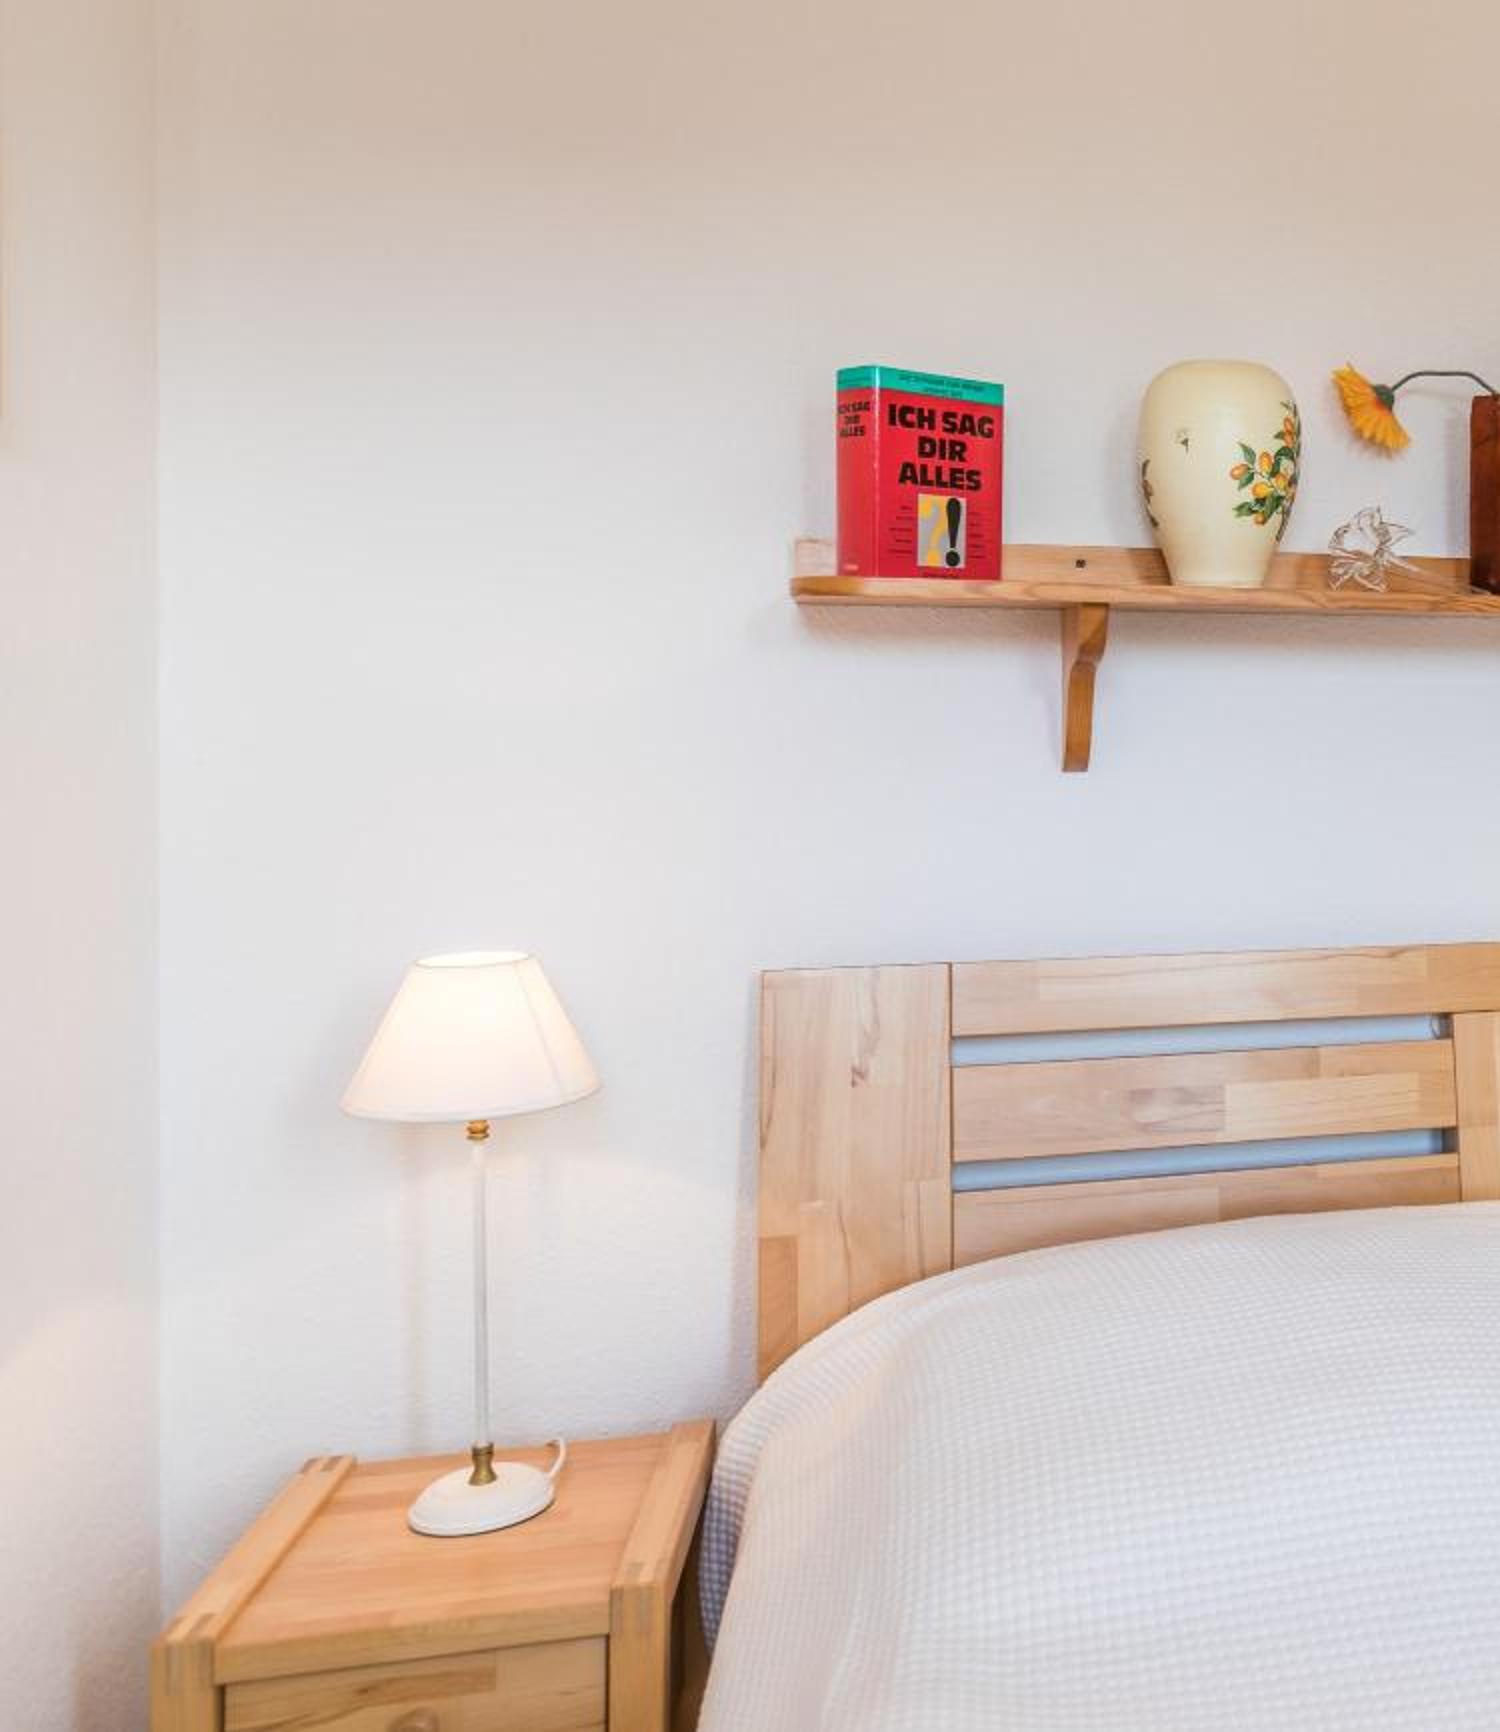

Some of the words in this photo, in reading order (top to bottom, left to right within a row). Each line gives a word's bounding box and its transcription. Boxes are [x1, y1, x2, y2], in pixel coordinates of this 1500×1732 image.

[888, 404, 936, 431] ICH
[942, 411, 994, 438] SAG
[917, 436, 967, 462] DIR
[898, 462, 982, 491] ALLES
